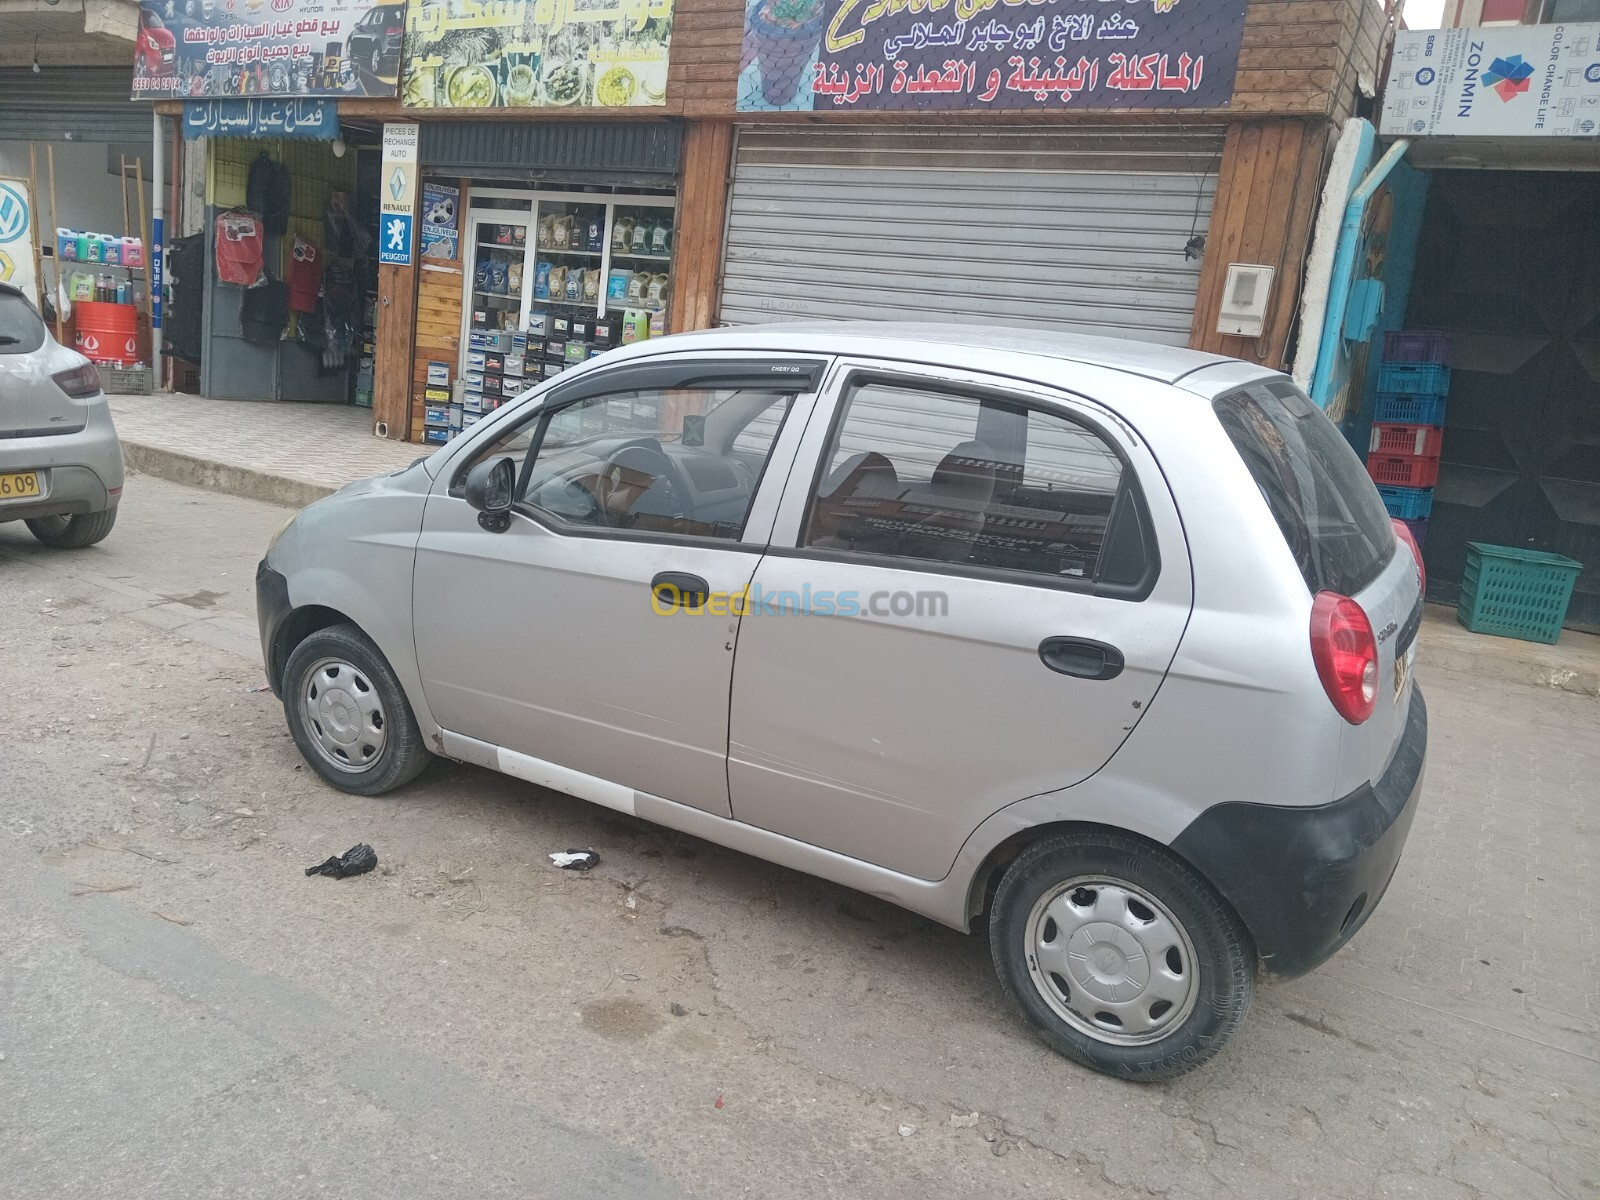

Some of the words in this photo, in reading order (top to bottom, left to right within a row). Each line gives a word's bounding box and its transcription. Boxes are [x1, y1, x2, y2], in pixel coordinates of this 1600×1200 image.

[274, 0, 292, 9] KIA
[183, 26, 219, 45] لواحقها
[219, 28, 227, 45] و
[227, 21, 269, 42] السيارات
[270, 20, 294, 40] غيار
[295, 18, 319, 38] قطع
[320, 19, 341, 37] بيع
[966, 19, 1014, 51] جابر
[1013, 16, 1045, 50] أبو
[1096, 13, 1139, 39] عند
[884, 20, 966, 60] الهلالي
[1424, 35, 1435, 57] SGS
[1440, 35, 1450, 65] PROTECTIVE
[1548, 26, 1565, 61] COLOR
[206, 48, 237, 66] الزيوت
[236, 42, 262, 65] أنواع
[262, 45, 290, 63] جميع
[291, 43, 311, 60] بيع
[811, 62, 885, 104] الزينة
[891, 59, 976, 93] القعدة
[1006, 56, 1100, 102] البنينة
[1106, 52, 1204, 93] الماكلة
[1457, 41, 1484, 118] ZONMIN
[977, 68, 1001, 101] و
[1537, 63, 1556, 105] CHANGE
[188, 98, 254, 132] السيارات
[1534, 107, 1547, 129] LIFE
[384, 137, 416, 147] RECHANGE
[385, 127, 406, 136] PIECES
[407, 127, 416, 136] DE
[390, 149, 407, 158] AUTO
[427, 184, 457, 195] ENJOLIVEUR
[383, 203, 412, 212] RENAULT
[423, 225, 457, 238] ENJOLIVEUR
[381, 252, 409, 262] PEUGEOT
[14, 475, 35, 493] 09
